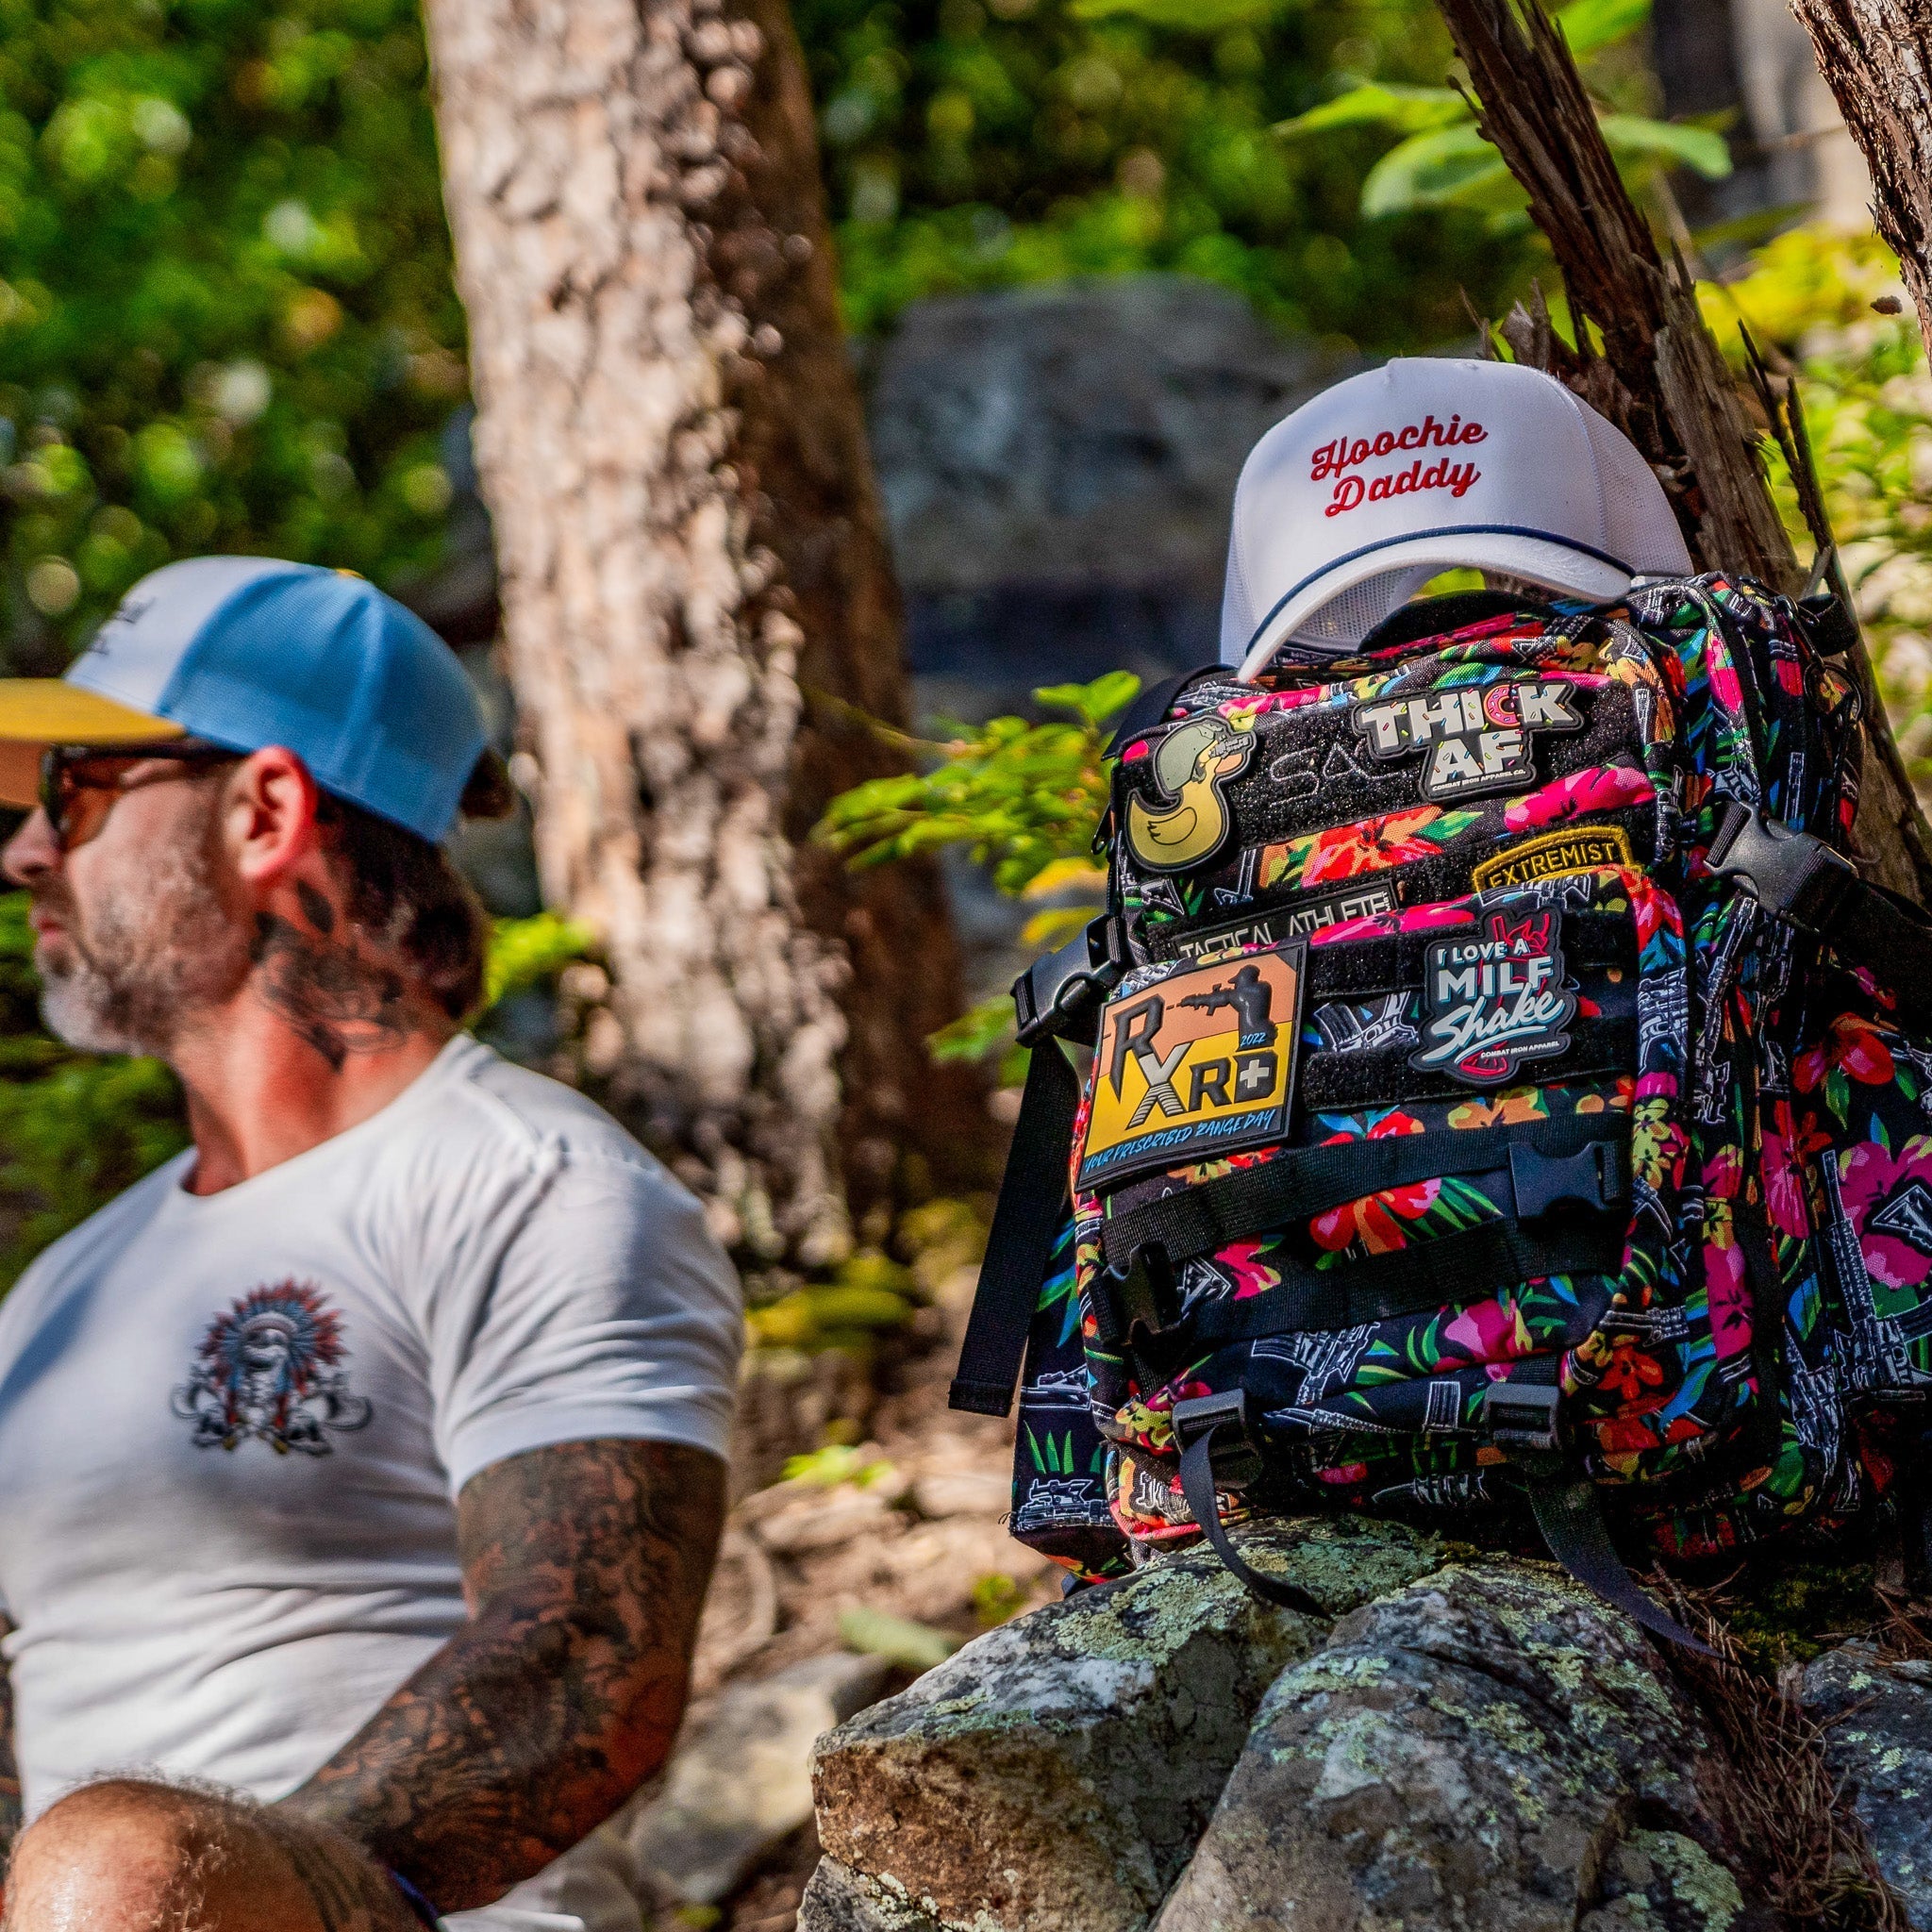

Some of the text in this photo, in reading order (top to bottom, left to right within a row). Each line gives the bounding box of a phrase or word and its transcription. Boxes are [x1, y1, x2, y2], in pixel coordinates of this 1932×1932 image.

[1310, 413, 1489, 481] Hoochie
[1324, 458, 1481, 518] Daddy
[1361, 684, 1574, 749] THICK
[1431, 730, 1524, 786] AF
[1432, 781, 1460, 791] COMBAT
[1461, 776, 1480, 786] IRON
[1480, 771, 1513, 782] APPAREL
[1489, 842, 1615, 889] EXTREMIST
[1437, 938, 1530, 966] I LOVE A
[1438, 956, 1554, 1003] MILF
[1241, 1032, 1267, 1048] 2022
[1422, 982, 1566, 1062] Shake
[1480, 1041, 1560, 1059] COMBAT IRON APPAREL
[1085, 1109, 1276, 1173] YOUR PRESCRIBED RANGE DAY
